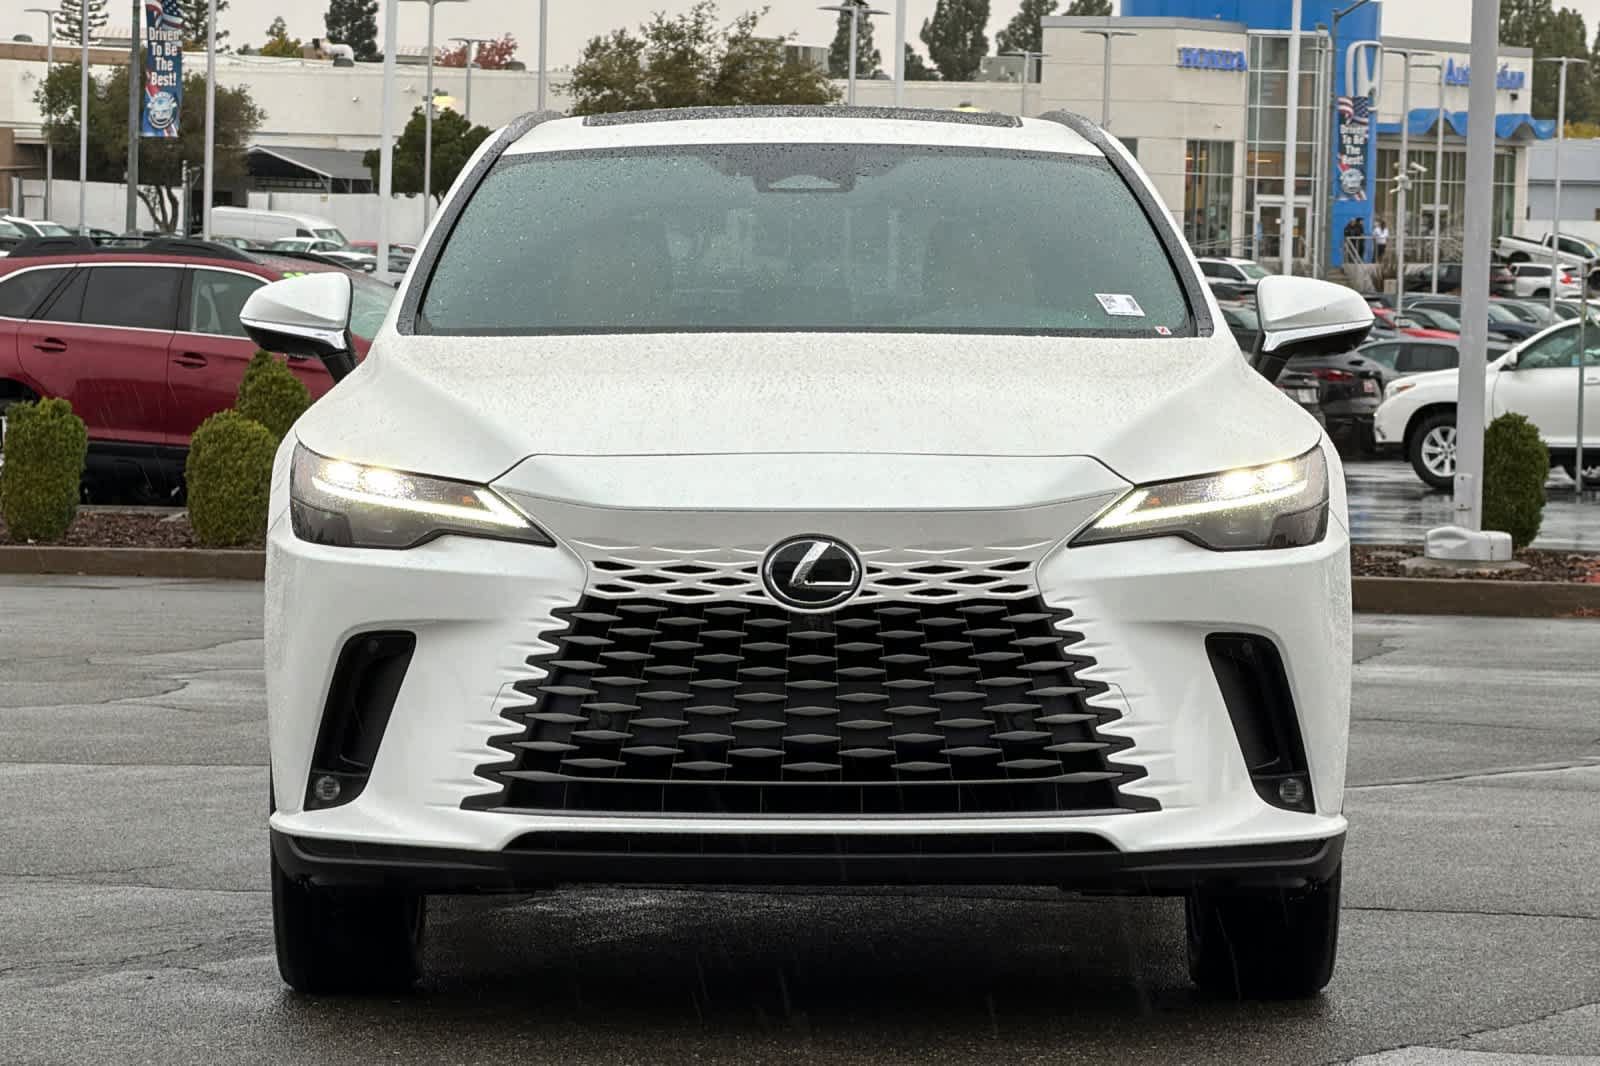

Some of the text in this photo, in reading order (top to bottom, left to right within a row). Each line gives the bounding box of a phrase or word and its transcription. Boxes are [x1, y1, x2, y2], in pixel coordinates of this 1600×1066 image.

[149, 27, 180, 41] Driven
[152, 42, 178, 56] To Be
[156, 57, 174, 71] The
[1176, 47, 1248, 72] HONDA
[151, 71, 176, 86] Best!
